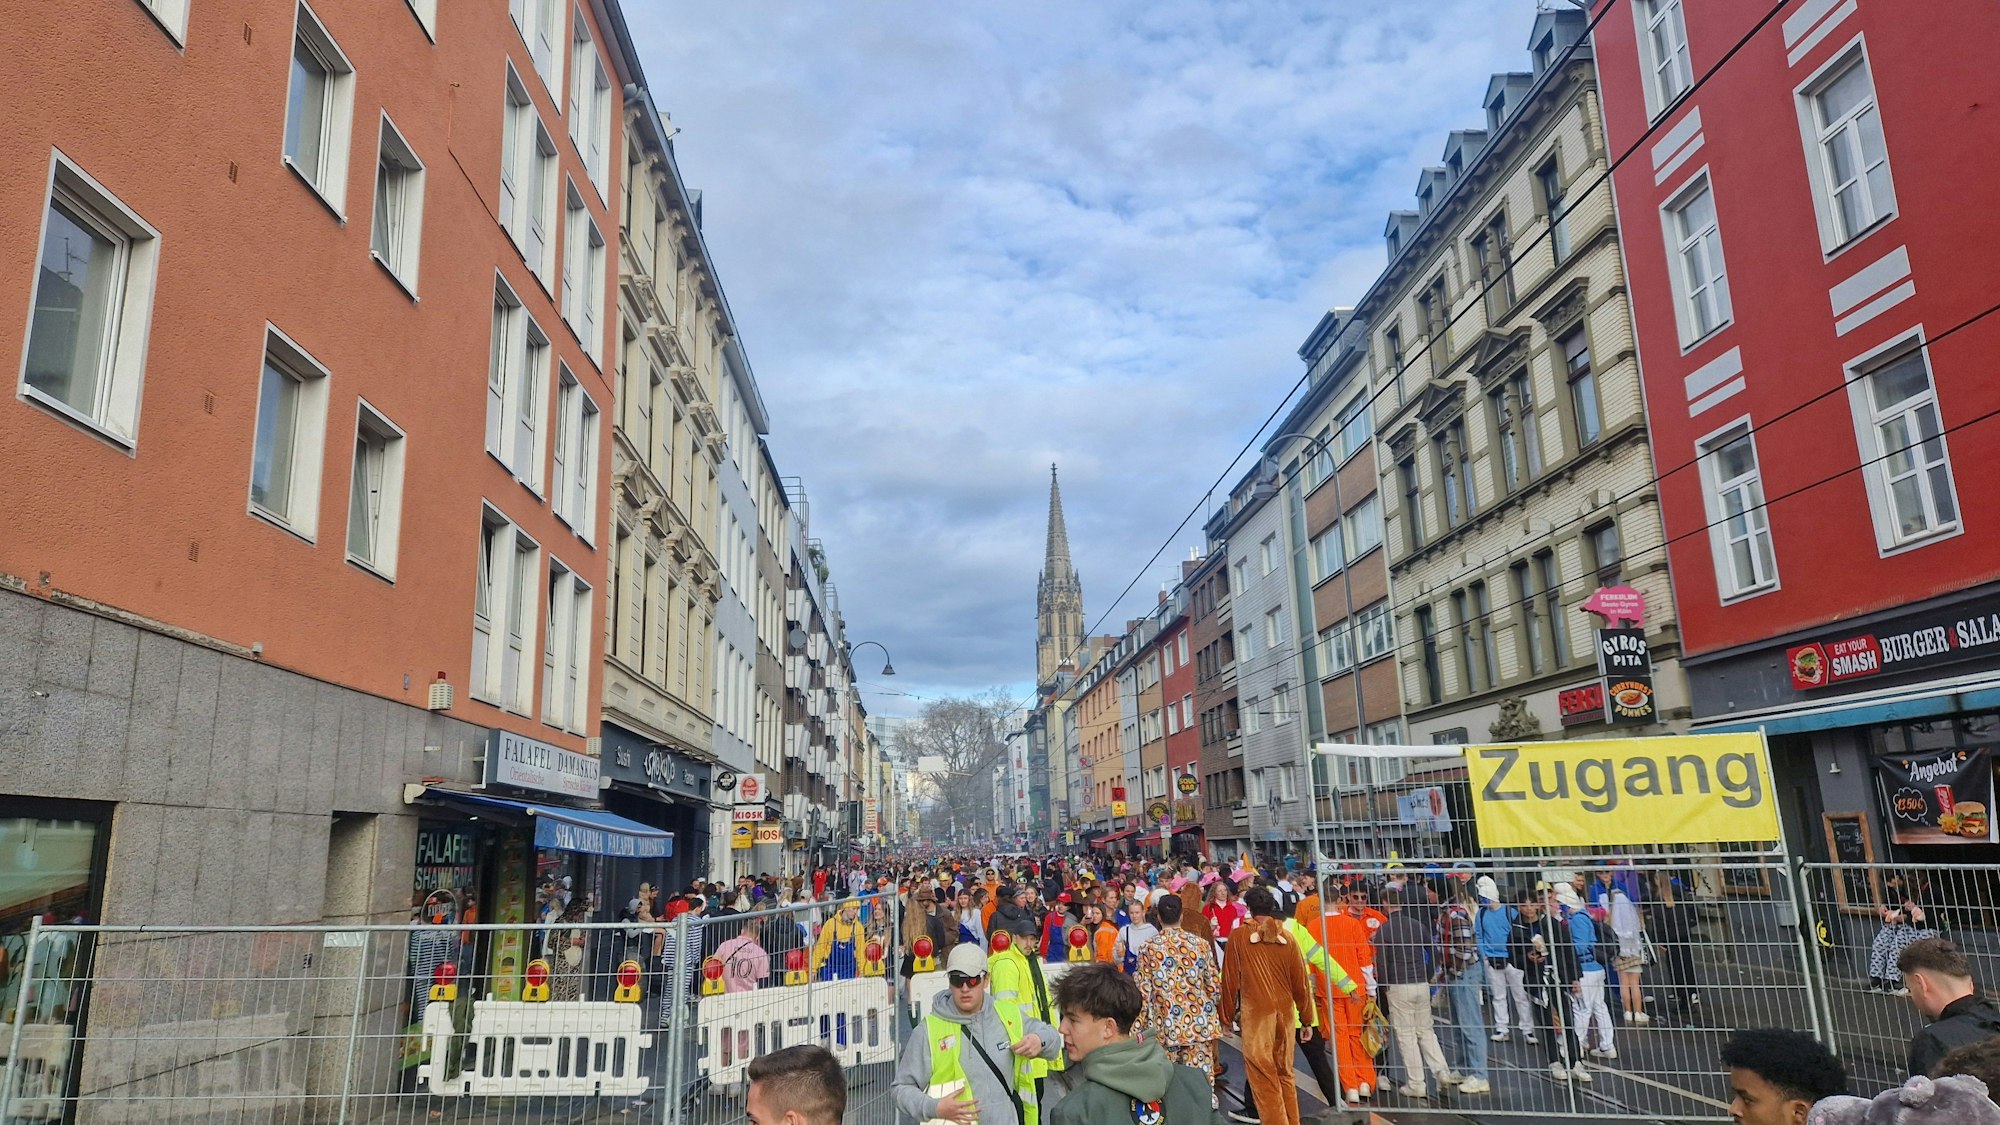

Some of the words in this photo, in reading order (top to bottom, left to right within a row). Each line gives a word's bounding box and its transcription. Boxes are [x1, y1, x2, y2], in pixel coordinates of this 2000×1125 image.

[1602, 635, 1647, 655] GYROS
[1834, 642, 1847, 654] EAT
[1847, 638, 1867, 651] YOUR
[1880, 626, 1949, 664] BURGER
[1613, 655, 1642, 666] PITA
[1832, 650, 1878, 676] SMASH
[1609, 681, 1653, 697] CURRYWURST
[1615, 704, 1652, 717] POMMES
[504, 738, 551, 770] FALAFEL
[557, 752, 599, 781] DAMASKUS
[615, 745, 630, 767] Sushi
[1910, 752, 1958, 782] Angebot
[1479, 748, 1762, 813] Zugang
[735, 811, 763, 819] KIOSK
[417, 832, 475, 864] FALAFEL
[415, 866, 473, 891] SHAWARMA
[730, 956, 752, 979] 10
